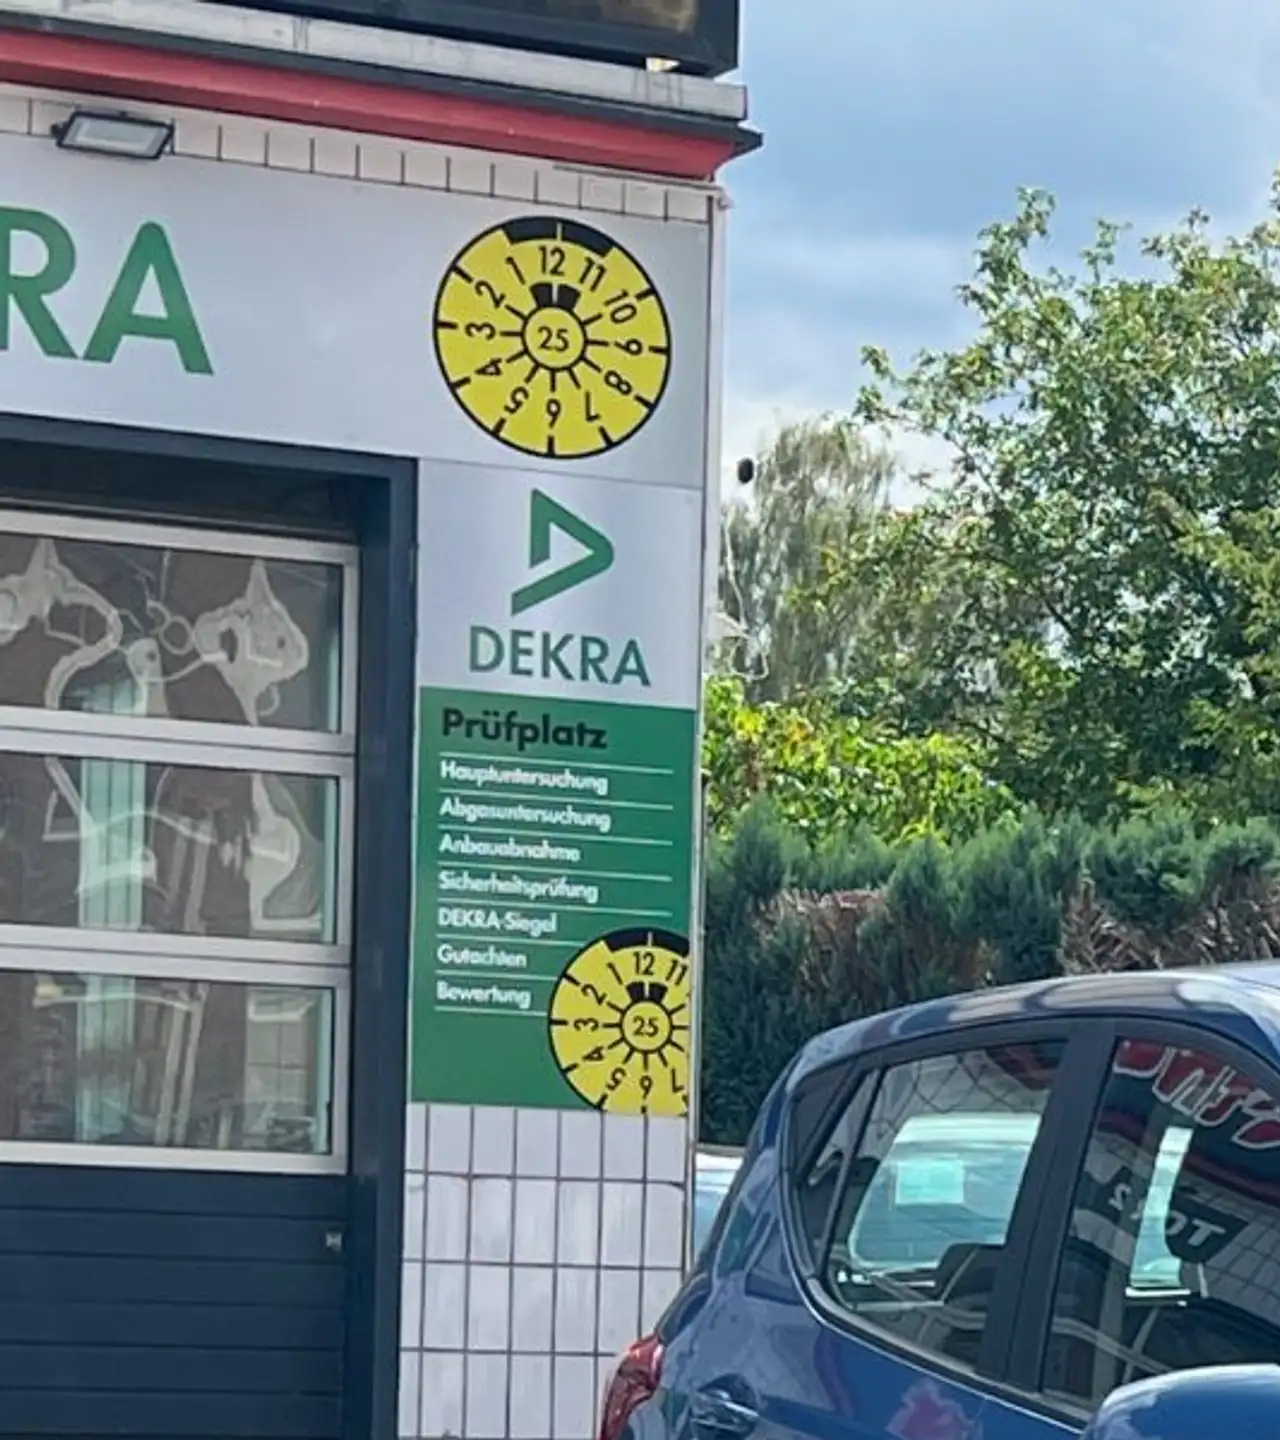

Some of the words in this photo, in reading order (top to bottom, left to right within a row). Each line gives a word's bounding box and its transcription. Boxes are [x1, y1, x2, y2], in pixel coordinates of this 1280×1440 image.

[504, 256, 526, 285] 1
[539, 246, 566, 276] 12
[578, 256, 608, 292] 11
[474, 280, 506, 308] 2
[604, 289, 638, 324] 10
[464, 322, 496, 341] 3
[537, 326, 570, 352] 25
[614, 338, 643, 356] 9
[475, 358, 502, 376] 4
[604, 370, 632, 395] 8
[504, 386, 530, 413] 5
[546, 398, 562, 428] 6
[469, 625, 651, 687] DEKRA
[442, 708, 608, 752] Prüfplatz
[440, 759, 609, 796] Hauptuntersuchung
[439, 797, 612, 833] Abgasuntersuchung
[439, 834, 581, 862] Anbauabnahme
[438, 870, 599, 904] Sicherheitsprüfung
[438, 908, 558, 938] DEKRA-Siegel
[437, 944, 527, 968] Gutachten
[632, 952, 655, 975] 12
[607, 963, 624, 985] 1
[666, 960, 688, 986] 11
[436, 981, 532, 1009] Bewertung
[580, 983, 606, 1005] 2
[573, 1017, 599, 1032] 3
[632, 1016, 659, 1037] 25
[582, 1047, 605, 1061] 4
[606, 1068, 626, 1091] 5
[639, 1076, 653, 1098] 6
[671, 1068, 684, 1093] 7
